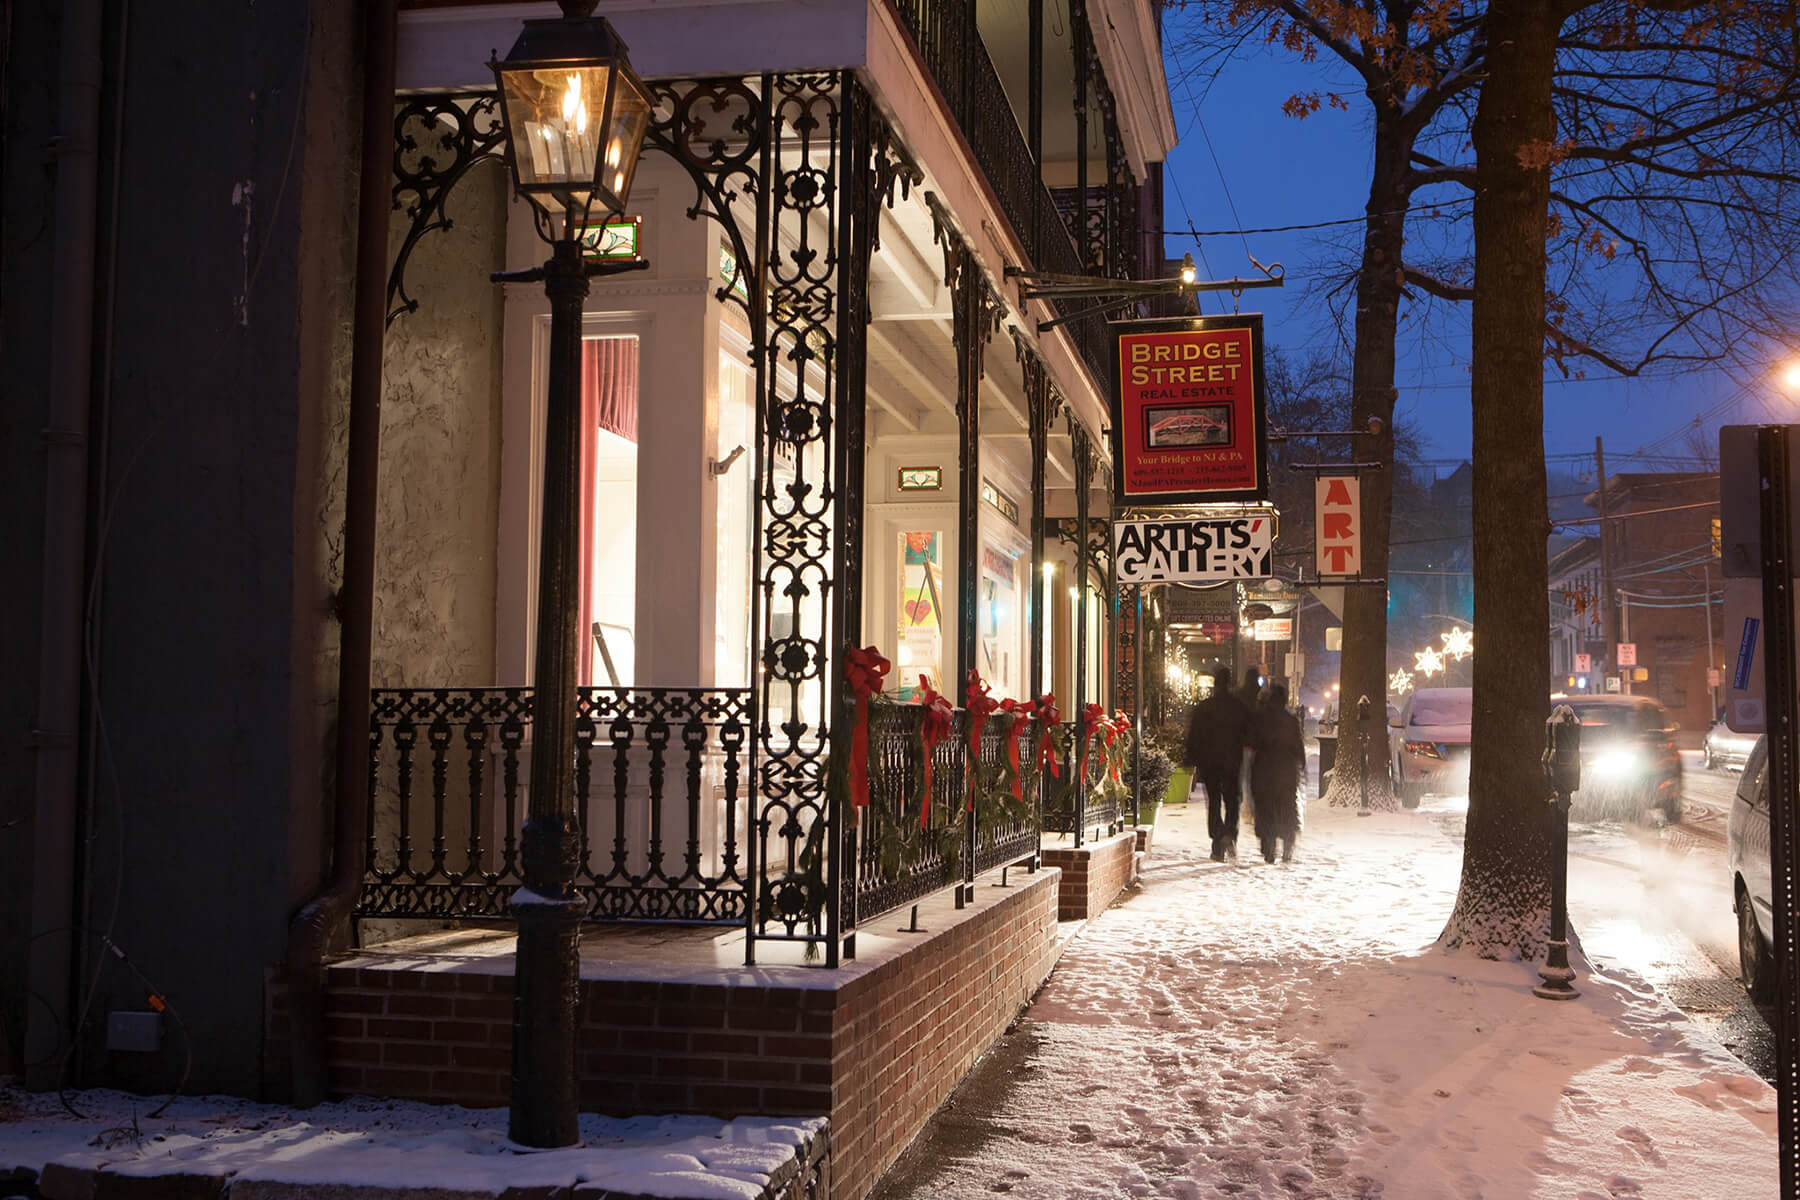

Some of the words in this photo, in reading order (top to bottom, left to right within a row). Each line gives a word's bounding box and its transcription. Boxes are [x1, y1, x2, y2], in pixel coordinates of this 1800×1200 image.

[1131, 341, 1241, 363] BRIDGE
[1131, 363, 1242, 385] STREET
[1140, 389, 1177, 399] REAL
[1181, 386, 1235, 397] ESTATE
[1137, 455, 1157, 465] Your
[1161, 454, 1190, 465] Bridge
[1192, 454, 1201, 462] to
[1204, 453, 1216, 462] NJ
[1218, 453, 1226, 461] &
[1230, 452, 1243, 460] PA
[1324, 480, 1355, 572] ART
[1117, 547, 1270, 581] GALLERY
